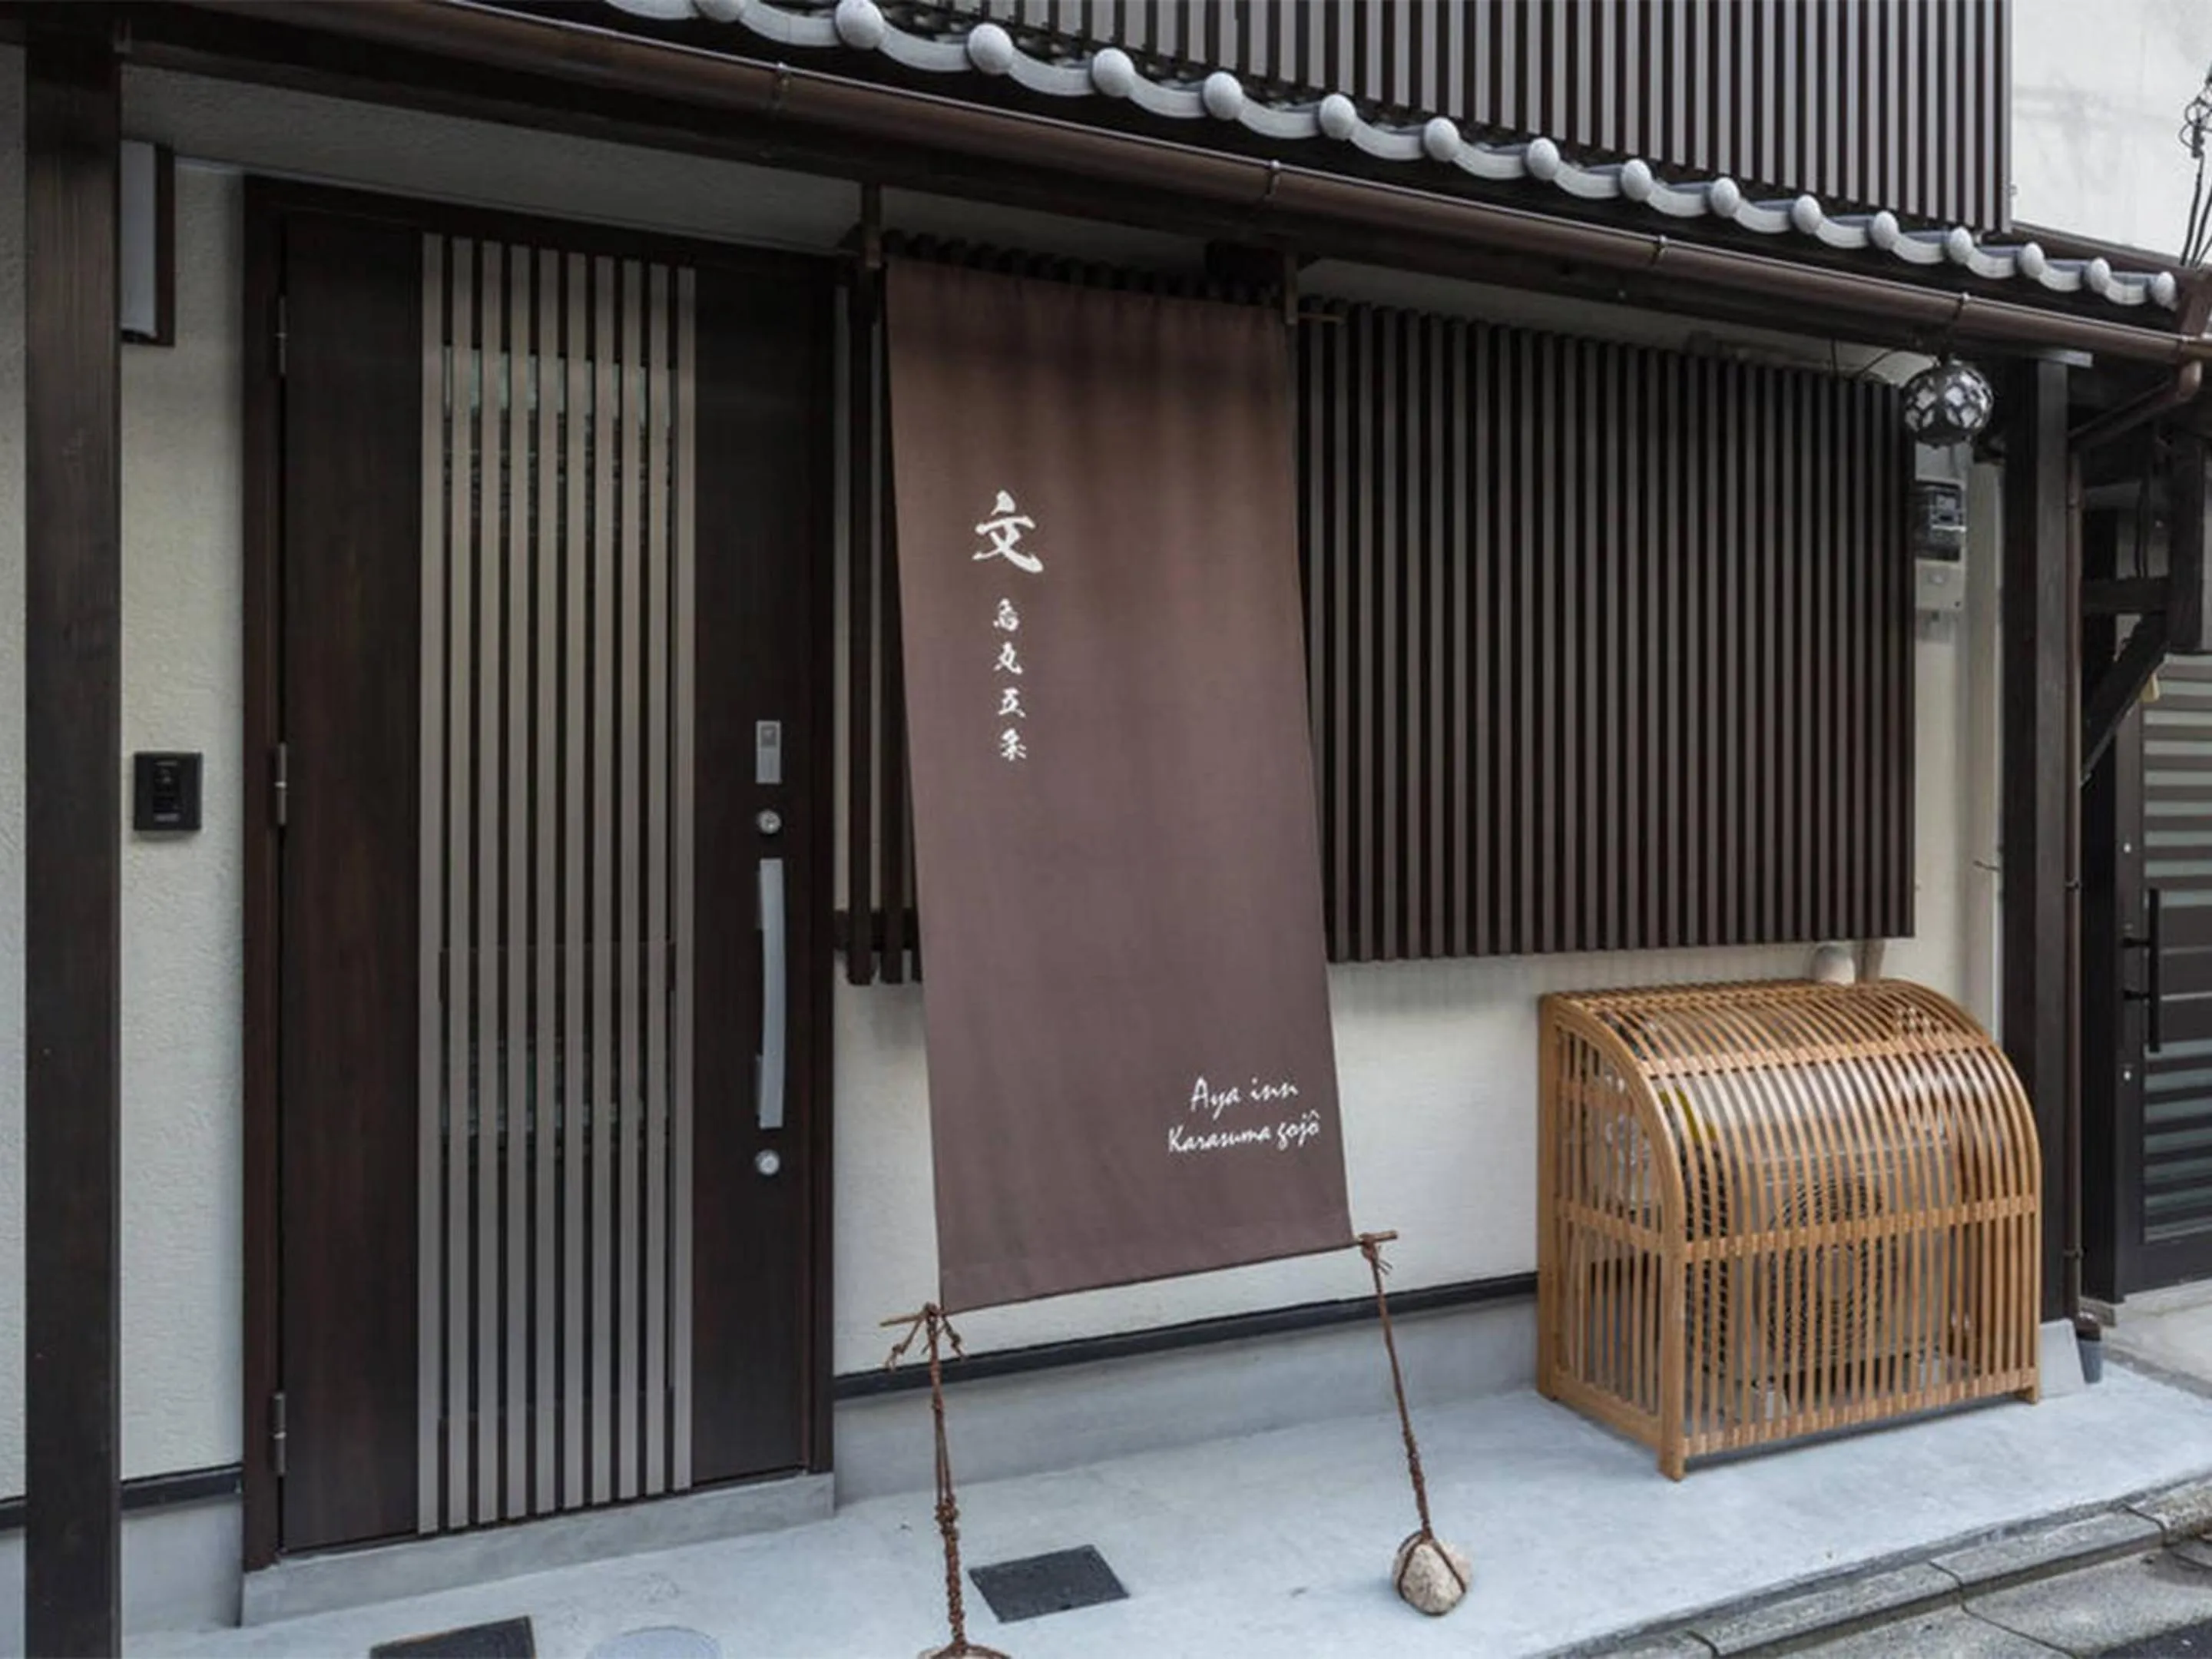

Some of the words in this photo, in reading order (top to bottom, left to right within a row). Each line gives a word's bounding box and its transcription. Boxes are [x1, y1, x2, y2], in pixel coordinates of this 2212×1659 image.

[972, 489, 1044, 573] 文
[1190, 1075, 1241, 1121] Aya
[1250, 1076, 1300, 1101] inn
[1167, 1124, 1273, 1153] Karasuma
